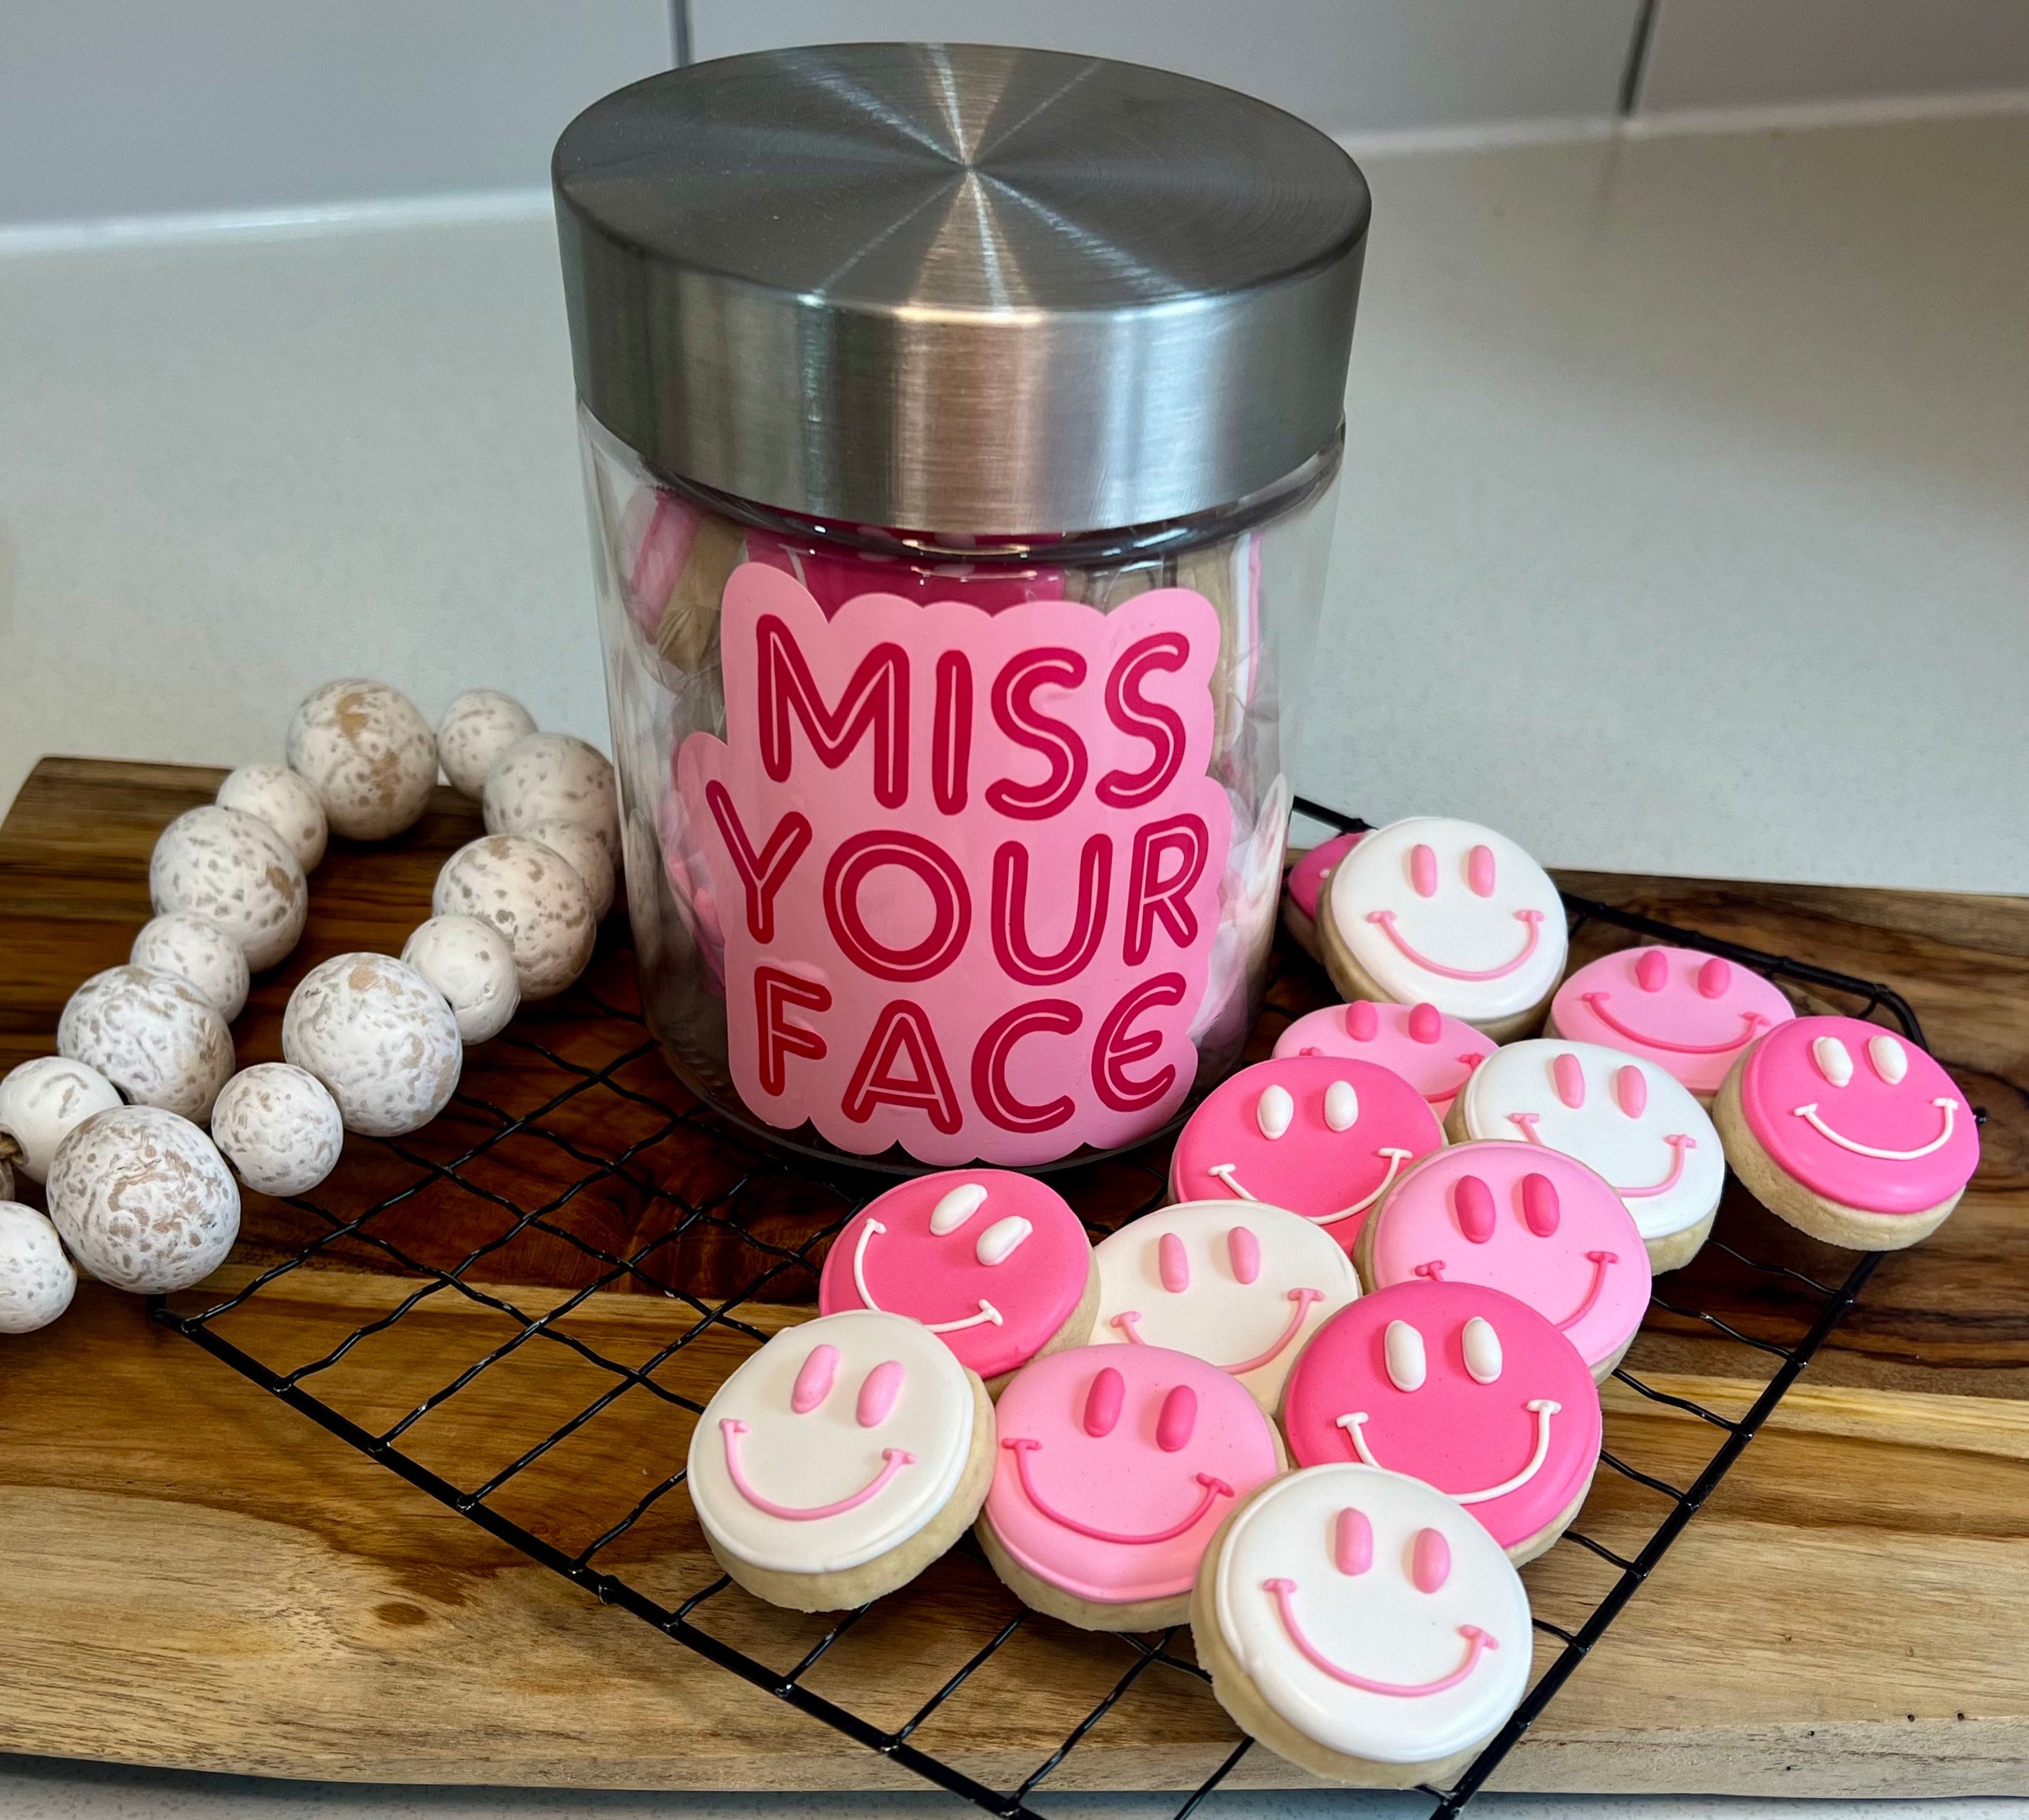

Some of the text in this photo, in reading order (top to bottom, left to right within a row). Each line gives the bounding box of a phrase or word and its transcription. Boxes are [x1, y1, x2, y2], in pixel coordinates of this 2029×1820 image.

[756, 614, 1190, 821] MISS
[706, 779, 1209, 986] YOUR
[754, 966, 1187, 1135] FACE
